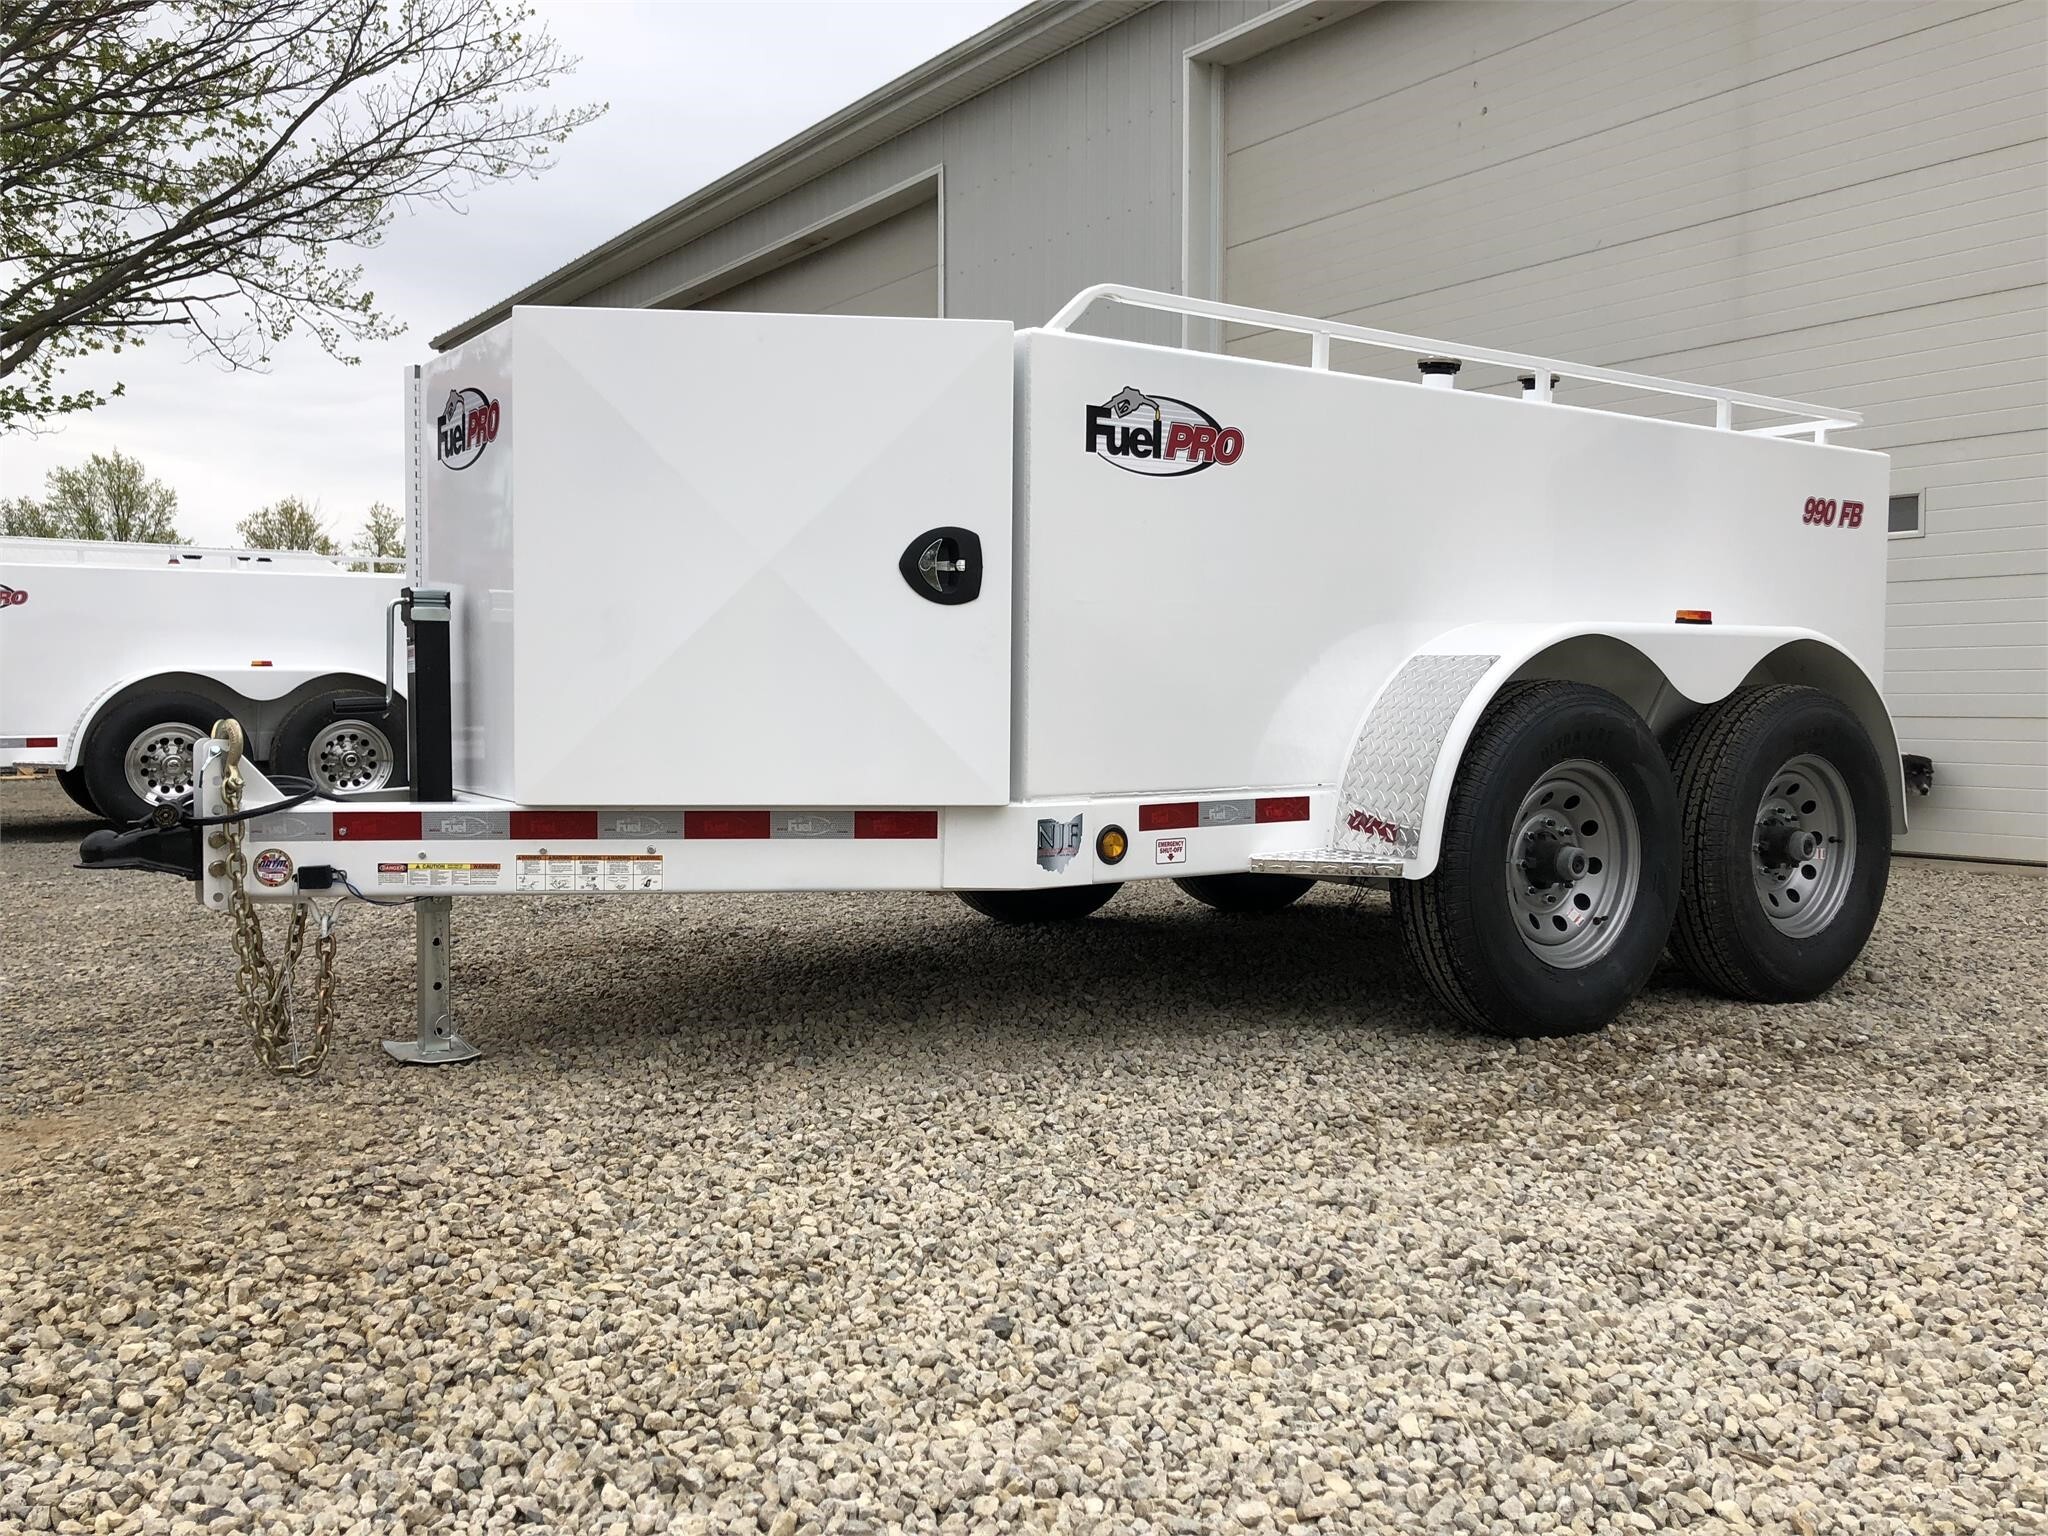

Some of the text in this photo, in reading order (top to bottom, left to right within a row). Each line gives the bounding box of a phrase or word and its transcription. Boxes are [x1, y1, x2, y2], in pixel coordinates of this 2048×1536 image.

[437, 398, 500, 461] Fuel PRO
[1086, 404, 1245, 466] Fuel PRO
[1802, 496, 1864, 529] 990 FB
[1208, 808, 1226, 821] Fuel
[441, 820, 467, 833] Fuel
[616, 819, 641, 832] Fuel
[787, 819, 812, 832] Fuel
[1039, 823, 1079, 855] NJF
[1160, 846, 1183, 854] SHUT-OFF
[380, 864, 406, 872] DANGER
